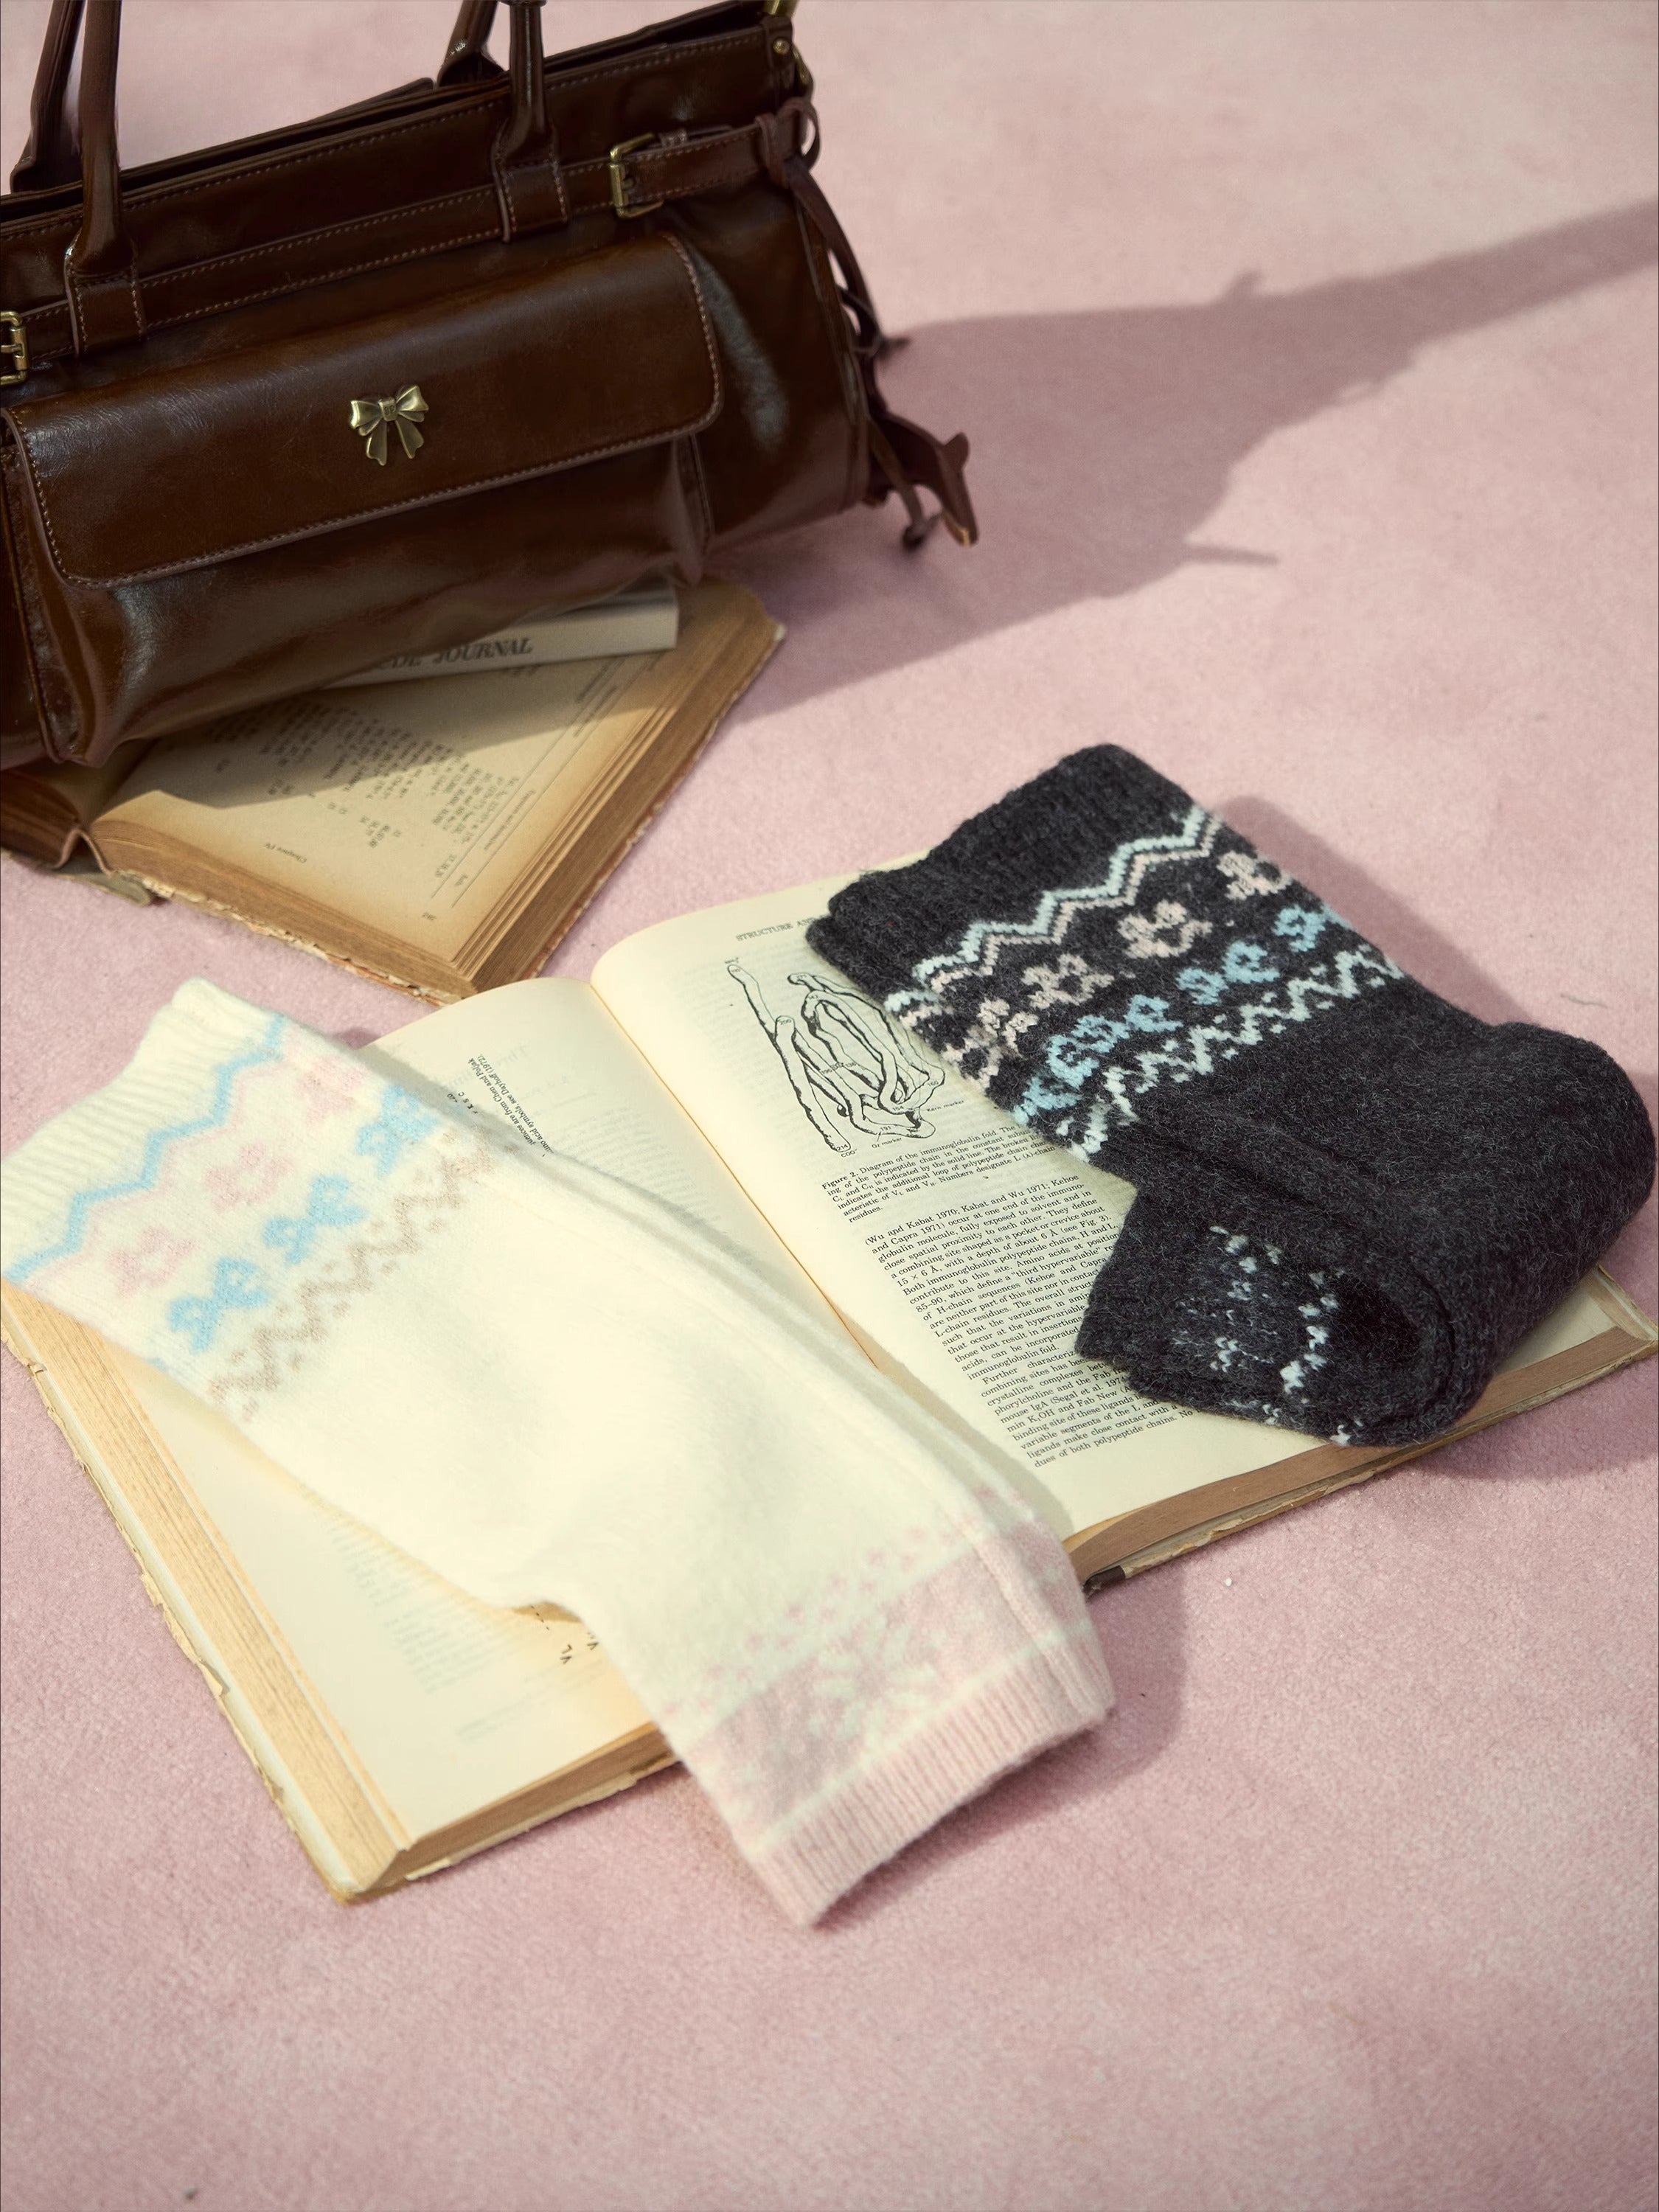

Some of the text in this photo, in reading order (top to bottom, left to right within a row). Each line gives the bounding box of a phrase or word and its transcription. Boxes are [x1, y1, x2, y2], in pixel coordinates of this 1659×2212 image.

[736, 922, 793, 941] STRUCTURE
[468, 1058, 484, 1077] Poljak
[479, 1075, 493, 1087] and
[489, 1074, 509, 1096] Dayhoff
[490, 1086, 503, 1102] Chen
[500, 1101, 513, 1116] from
[507, 1095, 517, 1105] see
[943, 1099, 965, 1109] marker
[509, 1115, 520, 1125] are
[529, 1128, 543, 1141] acid
[821, 1176, 849, 1190] Figure
[859, 1160, 894, 1174] Diagram
[919, 1135, 981, 1156] immunoglobulin
[981, 1130, 998, 1139] fold.
[837, 1143, 848, 1152] 214
[882, 1137, 903, 1147] marker
[827, 1187, 842, 1196] ing
[844, 1180, 852, 1189] of
[872, 1161, 917, 1179] polypeptide
[919, 1154, 941, 1164] chain
[972, 1136, 1004, 1150] constant
[837, 1192, 873, 1209] indicates
[874, 1186, 889, 1194] the
[892, 1172, 931, 1189] additional
[931, 1168, 950, 1177] loop
[961, 1152, 1004, 1169] polypeptide
[1006, 1146, 1029, 1155] chain
[845, 1186, 860, 1197] and
[883, 1167, 919, 1183] indicated
[947, 1155, 966, 1164] solid
[1001, 1138, 1029, 1149] broken
[844, 1198, 880, 1217] acteristic
[881, 1192, 890, 1200] of
[905, 1183, 921, 1193] and
[937, 1170, 974, 1183] Numbers
[975, 1159, 1012, 1173] designate
[849, 1206, 883, 1222] residues.
[865, 1175, 1079, 1246] (Wu and Kabat 1970; Kabat and Wu 1971; Kehoe
[872, 1183, 1084, 1254] and Capra 1971) occur at one end of the immuno-
[878, 1244, 914, 1263] globulin
[917, 1230, 959, 1246] molecule,
[959, 1222, 980, 1233] fully
[983, 1211, 1017, 1226] exposed
[1018, 1208, 1029, 1216] to
[1030, 1199, 1062, 1213] solvent
[1060, 1192, 1081, 1203] and
[884, 1258, 906, 1270] close
[908, 1244, 939, 1260] spatial
[941, 1231, 982, 1250] proximity
[997, 1222, 1018, 1232] each
[1020, 1215, 1046, 1226] other.
[1046, 1207, 1069, 1217] They
[1071, 1199, 1098, 1210] define
[898, 1255, 945, 1275] combining
[945, 1249, 961, 1258] site
[961, 1238, 993, 1253] shaped
[1012, 1225, 1040, 1239] pocket
[1050, 1214, 1080, 1227] crevice
[1079, 1206, 1105, 1217] about
[902, 1282, 925, 1296] Both
[926, 1259, 998, 1285] immunoglobulin
[998, 1244, 1048, 1264] polypeptide
[1048, 1236, 1080, 1248] chains,
[1091, 1225, 1108, 1235] and
[910, 1283, 955, 1304] contribute
[971, 1270, 990, 1281] this
[993, 1265, 1012, 1274] site.
[1016, 1255, 1045, 1267] Amino
[1048, 1247, 1071, 1258] acids
[1074, 1242, 1084, 1251] at
[961, 1358, 988, 1371] acids,
[991, 1350, 1008, 1360] can
[1025, 1326, 1082, 1348] incorporated
[967, 1343, 1060, 1380] immunoglobulin fold.
[1034, 1407, 1194, 1467] dues of both polypeptide chains. No
